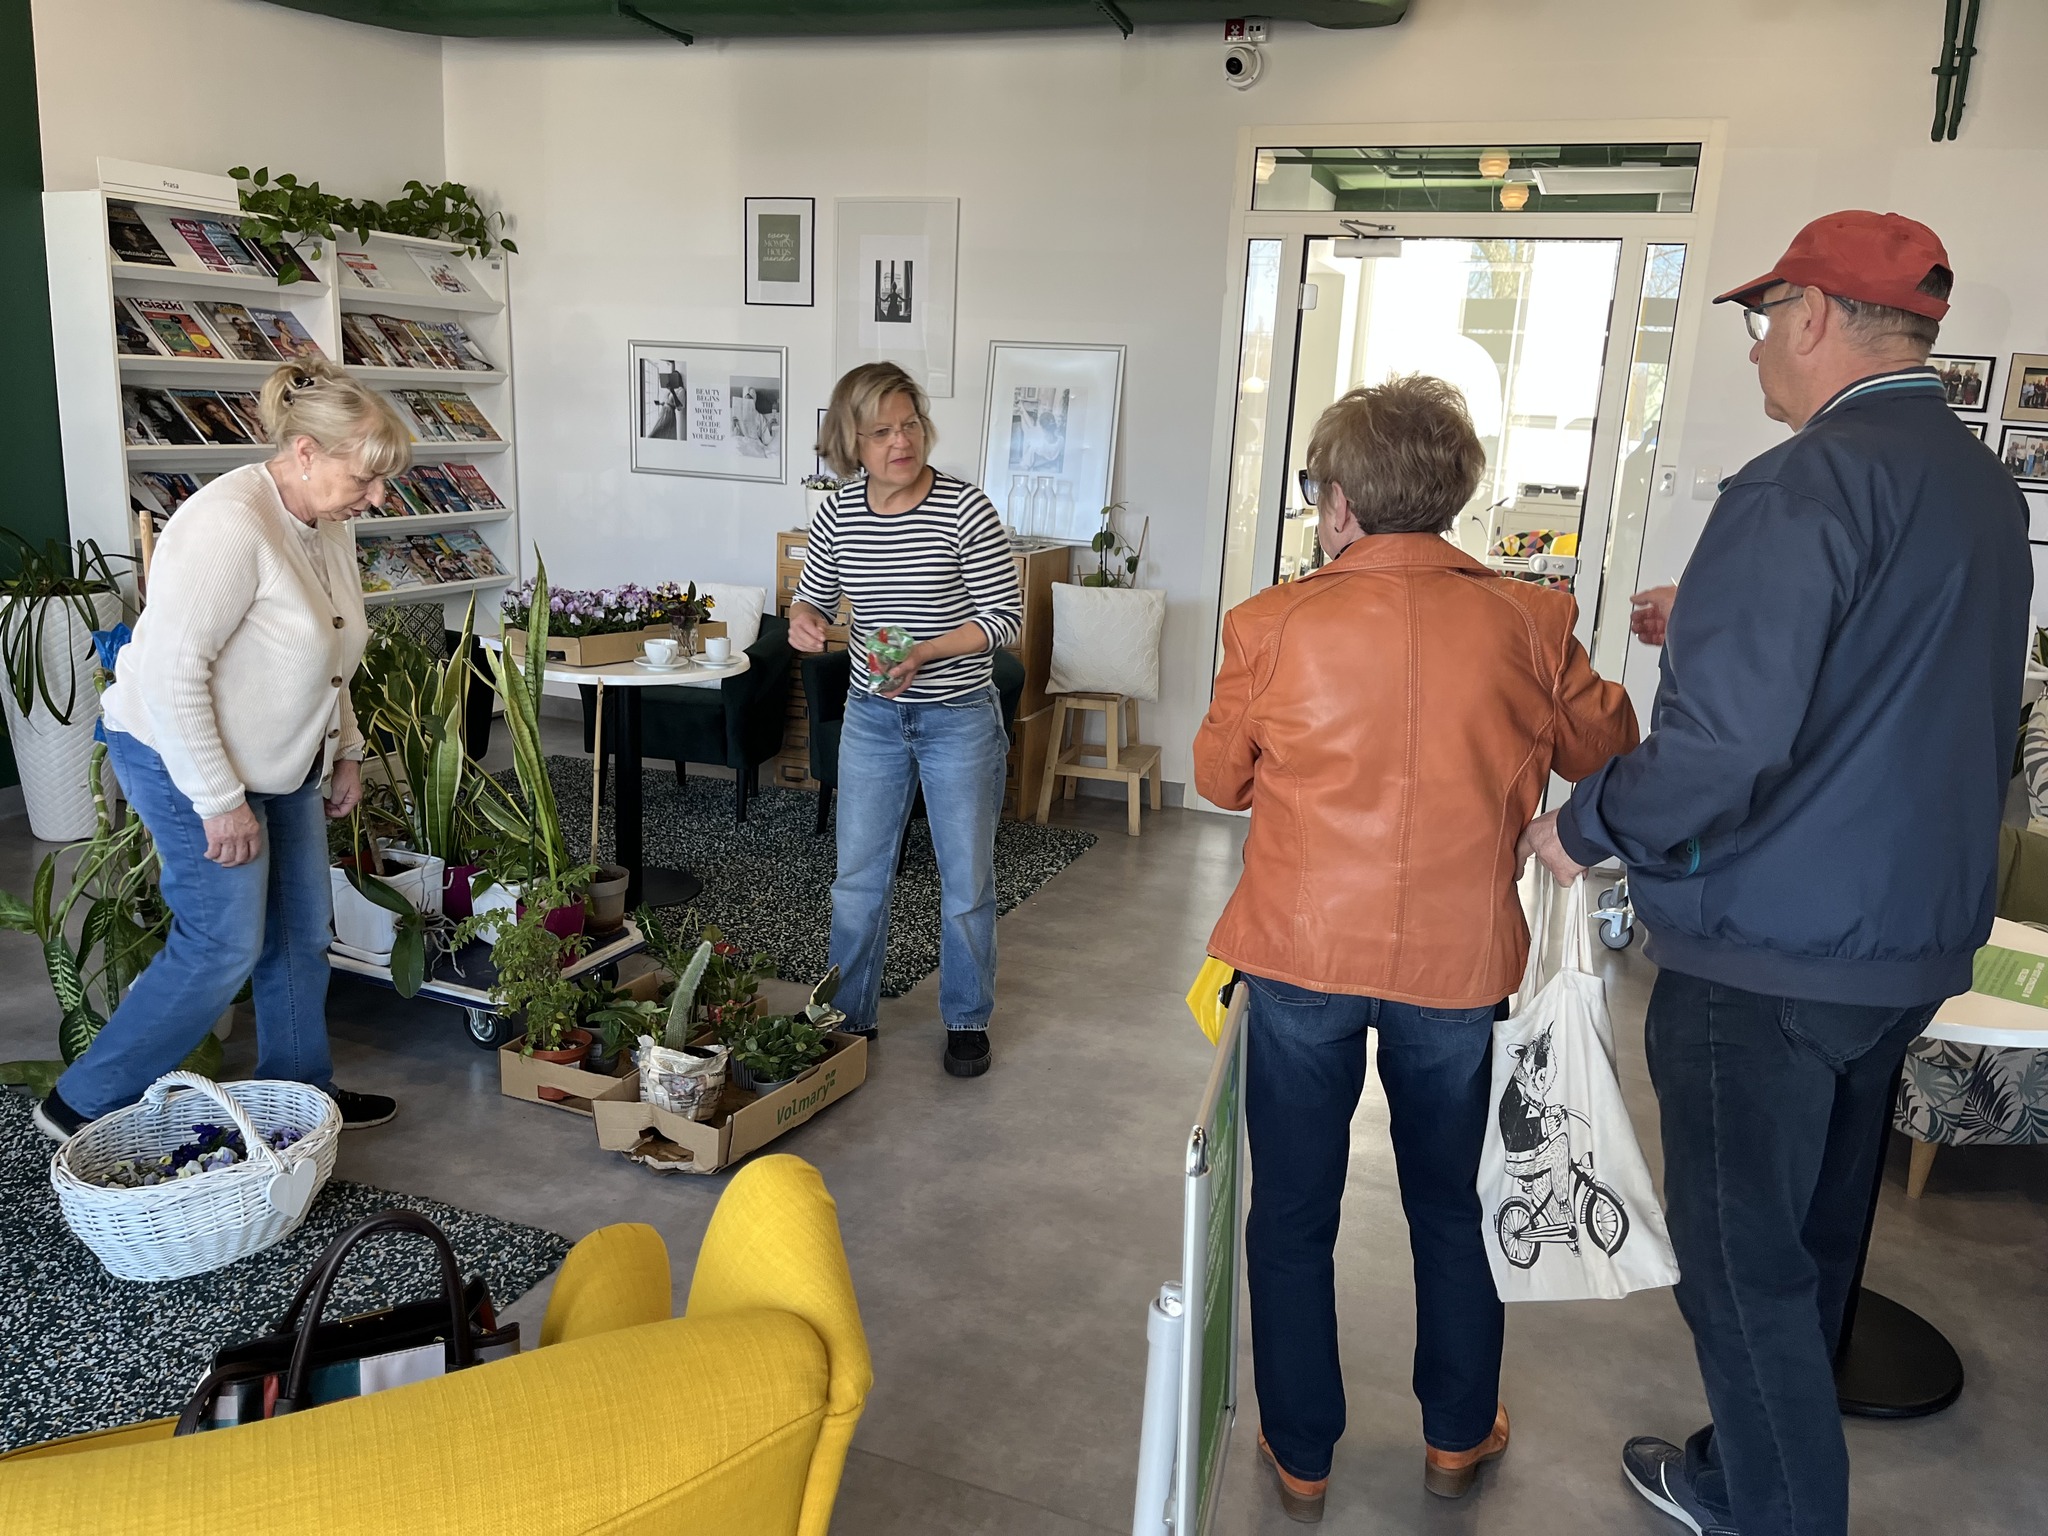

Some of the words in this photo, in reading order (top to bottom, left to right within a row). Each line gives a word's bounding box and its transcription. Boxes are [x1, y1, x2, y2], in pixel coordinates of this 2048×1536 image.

[163, 180, 179, 189] Prasa
[763, 239, 794, 248] MOMENT
[136, 299, 184, 311] książki
[695, 388, 720, 396] BEAUTY
[694, 407, 722, 415] MOMENT
[696, 420, 720, 428] DECIDE
[691, 432, 725, 441] YOURSELF
[777, 1082, 830, 1125] Volmary
